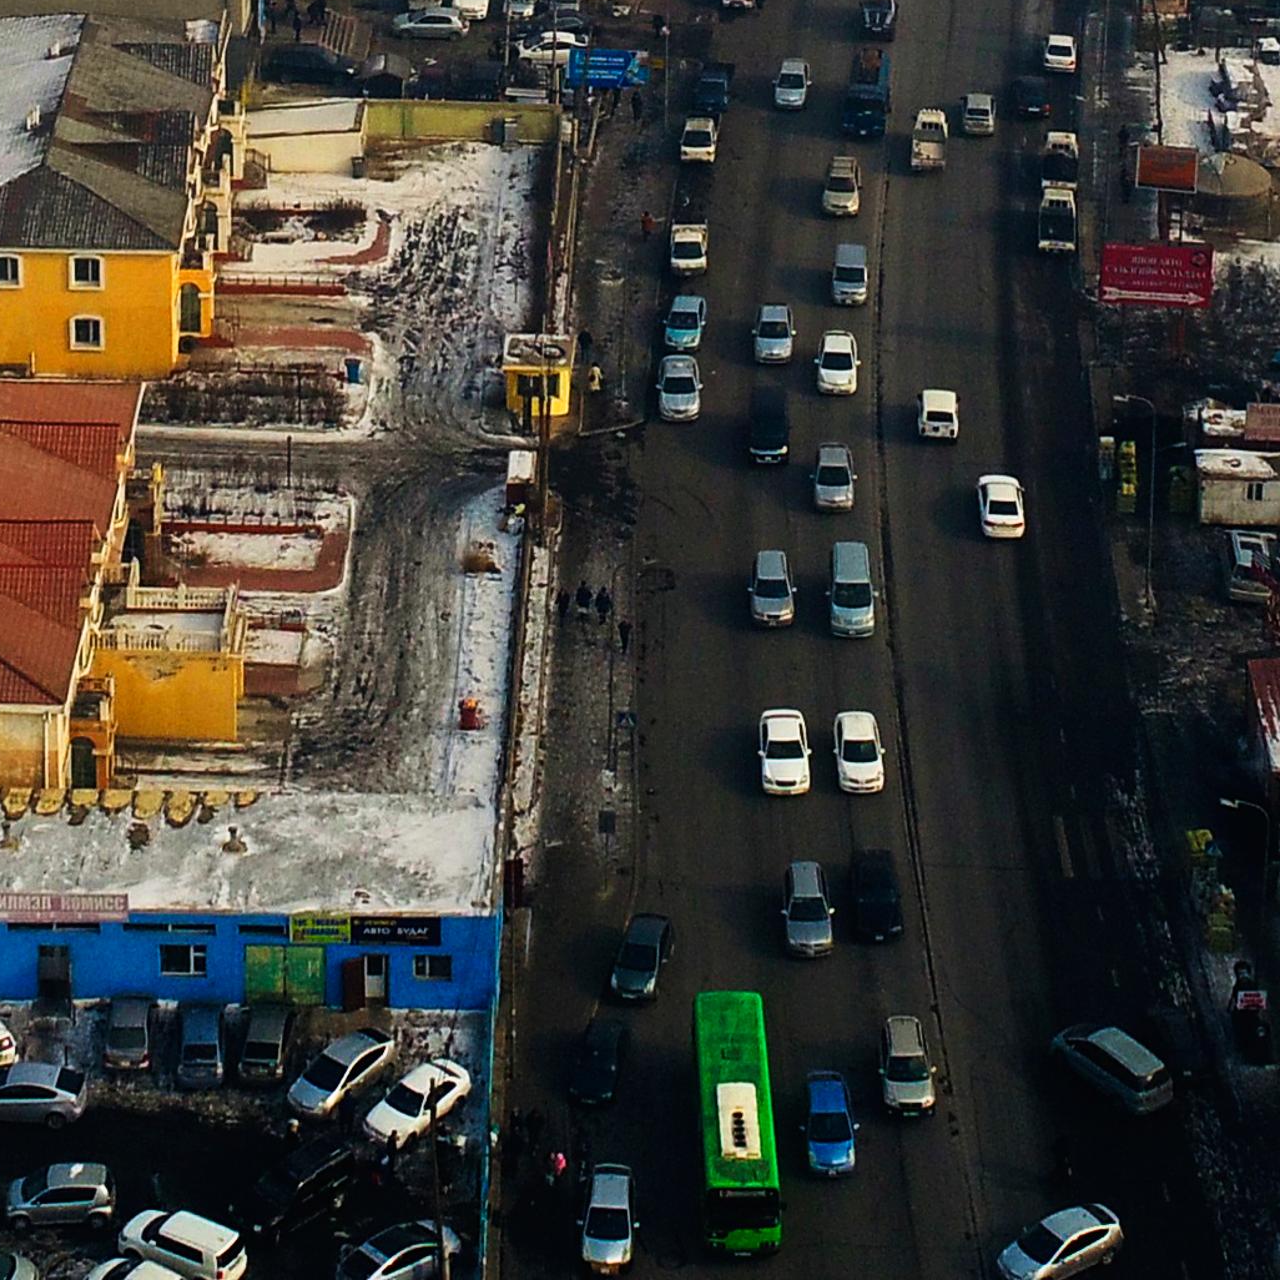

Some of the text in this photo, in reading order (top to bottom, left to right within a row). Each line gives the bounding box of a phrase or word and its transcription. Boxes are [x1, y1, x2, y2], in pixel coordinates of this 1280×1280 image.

[60, 895, 125, 911] КОМИСС
[363, 927, 430, 937] АВТО БУДАГ
